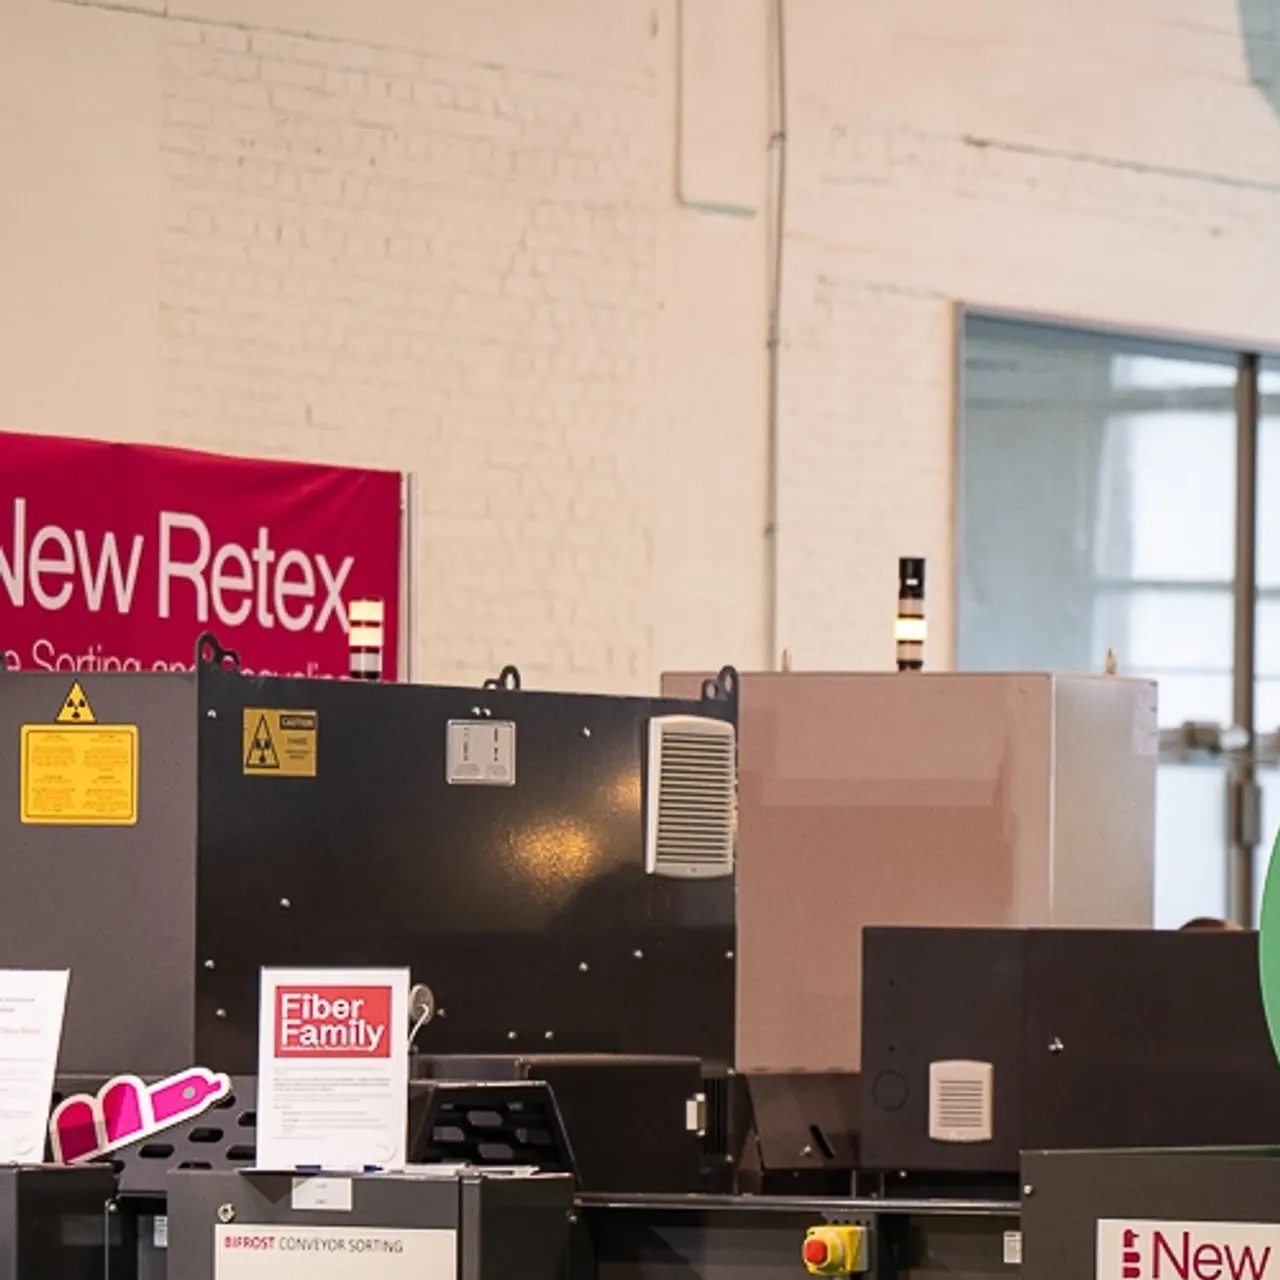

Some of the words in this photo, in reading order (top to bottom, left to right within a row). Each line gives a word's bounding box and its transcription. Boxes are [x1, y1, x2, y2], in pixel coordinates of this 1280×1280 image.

[159, 511, 355, 634] Retex
[281, 994, 364, 1020] Fiber
[281, 1019, 384, 1051] Family
[224, 1235, 275, 1250] BIFROST
[279, 1236, 346, 1252] CONVEYOR
[349, 1238, 404, 1254] SORTING
